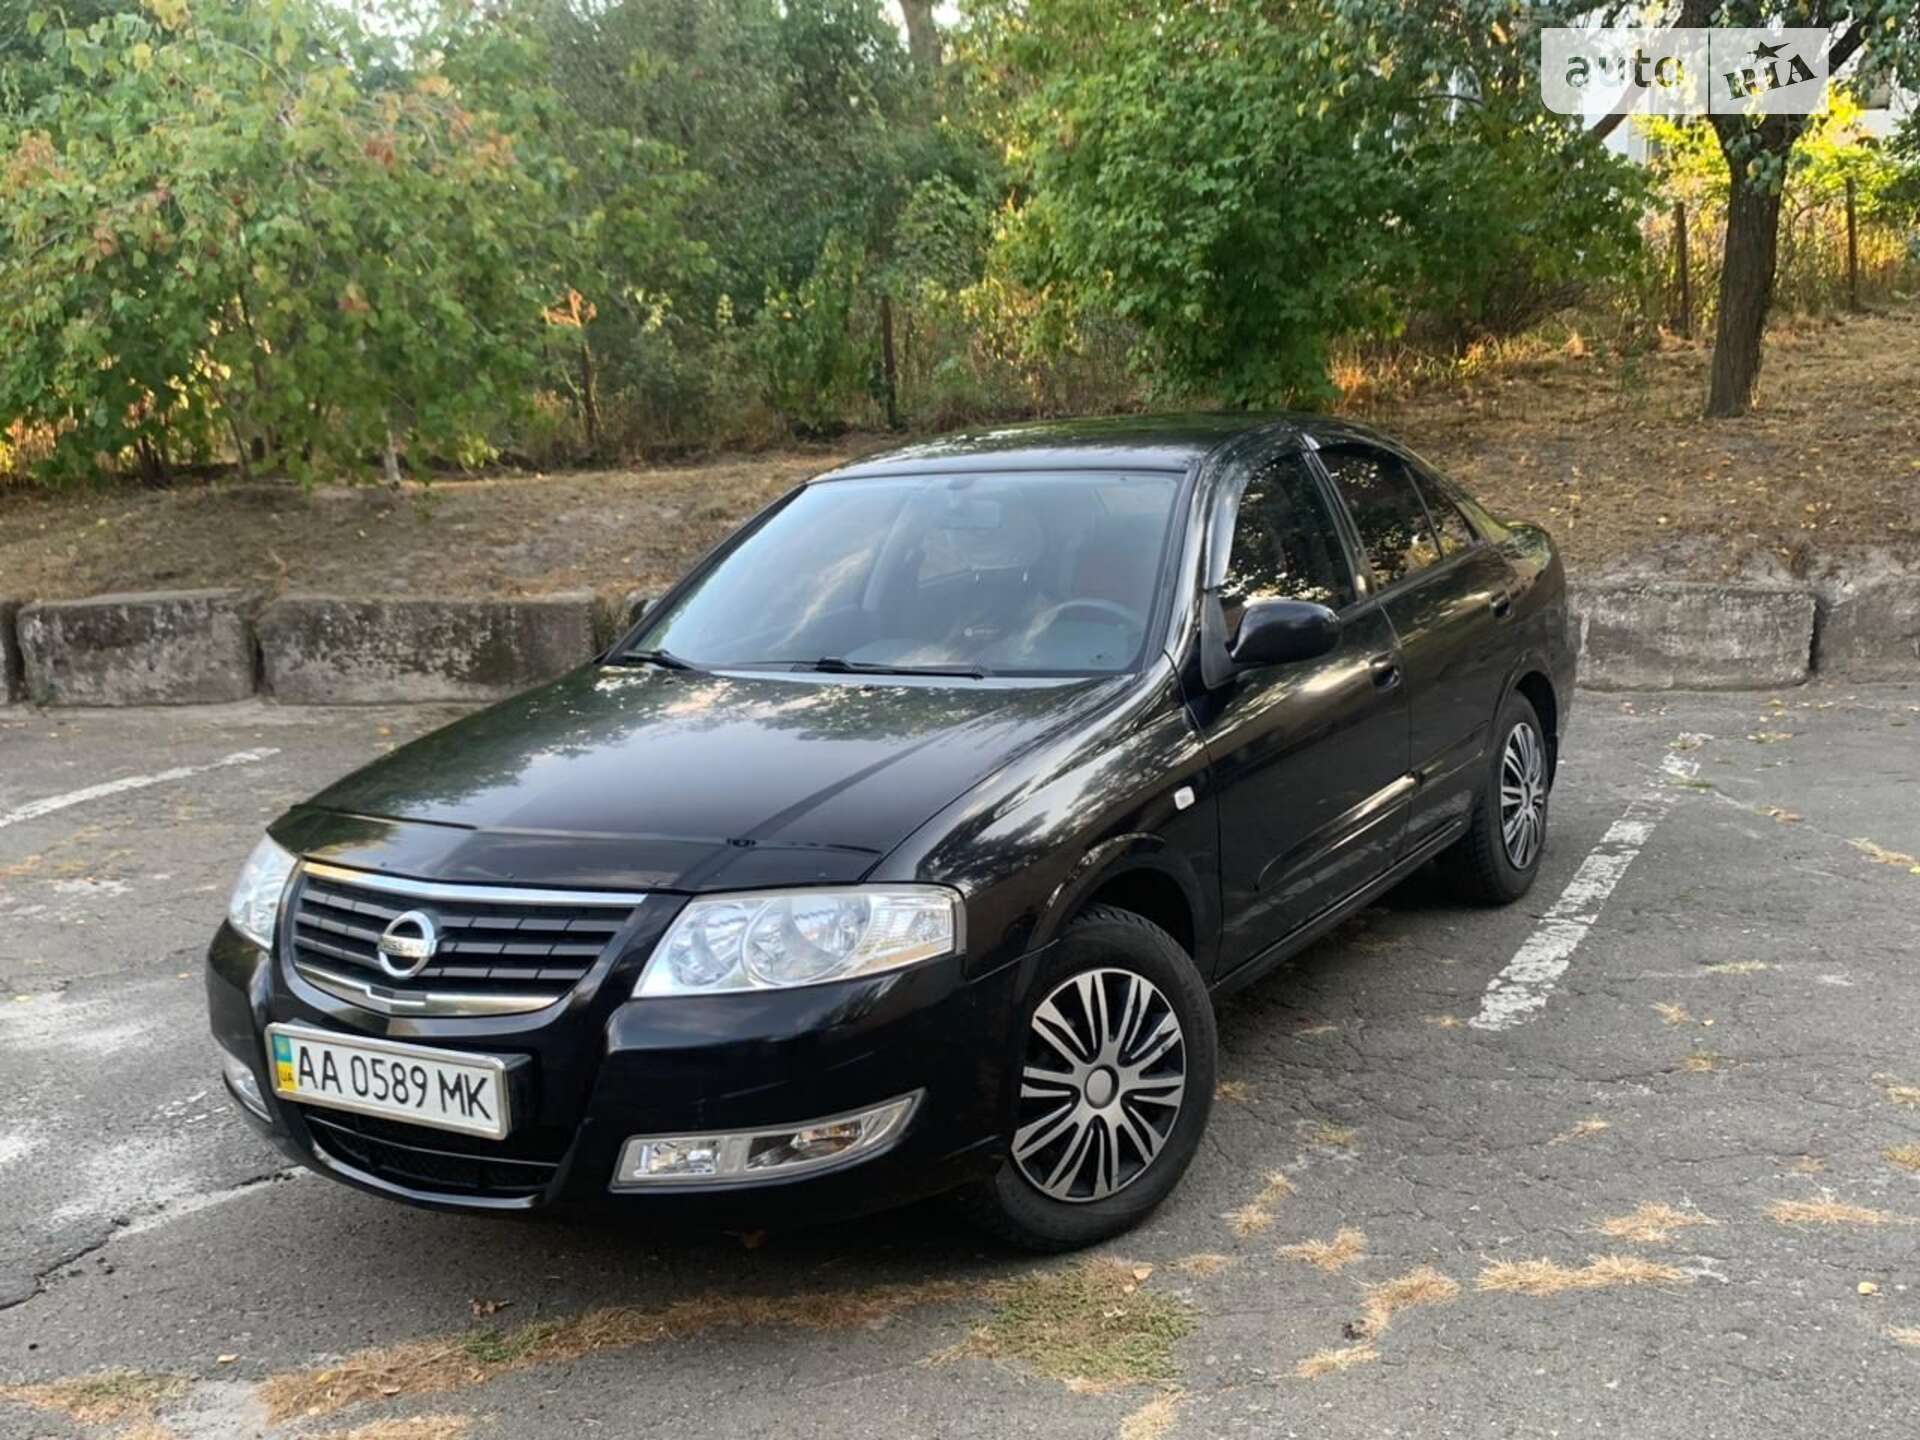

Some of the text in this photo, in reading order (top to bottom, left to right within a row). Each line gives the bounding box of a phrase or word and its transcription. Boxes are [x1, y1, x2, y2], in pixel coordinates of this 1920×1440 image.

[298, 1046, 492, 1121] AA 0589 MK
